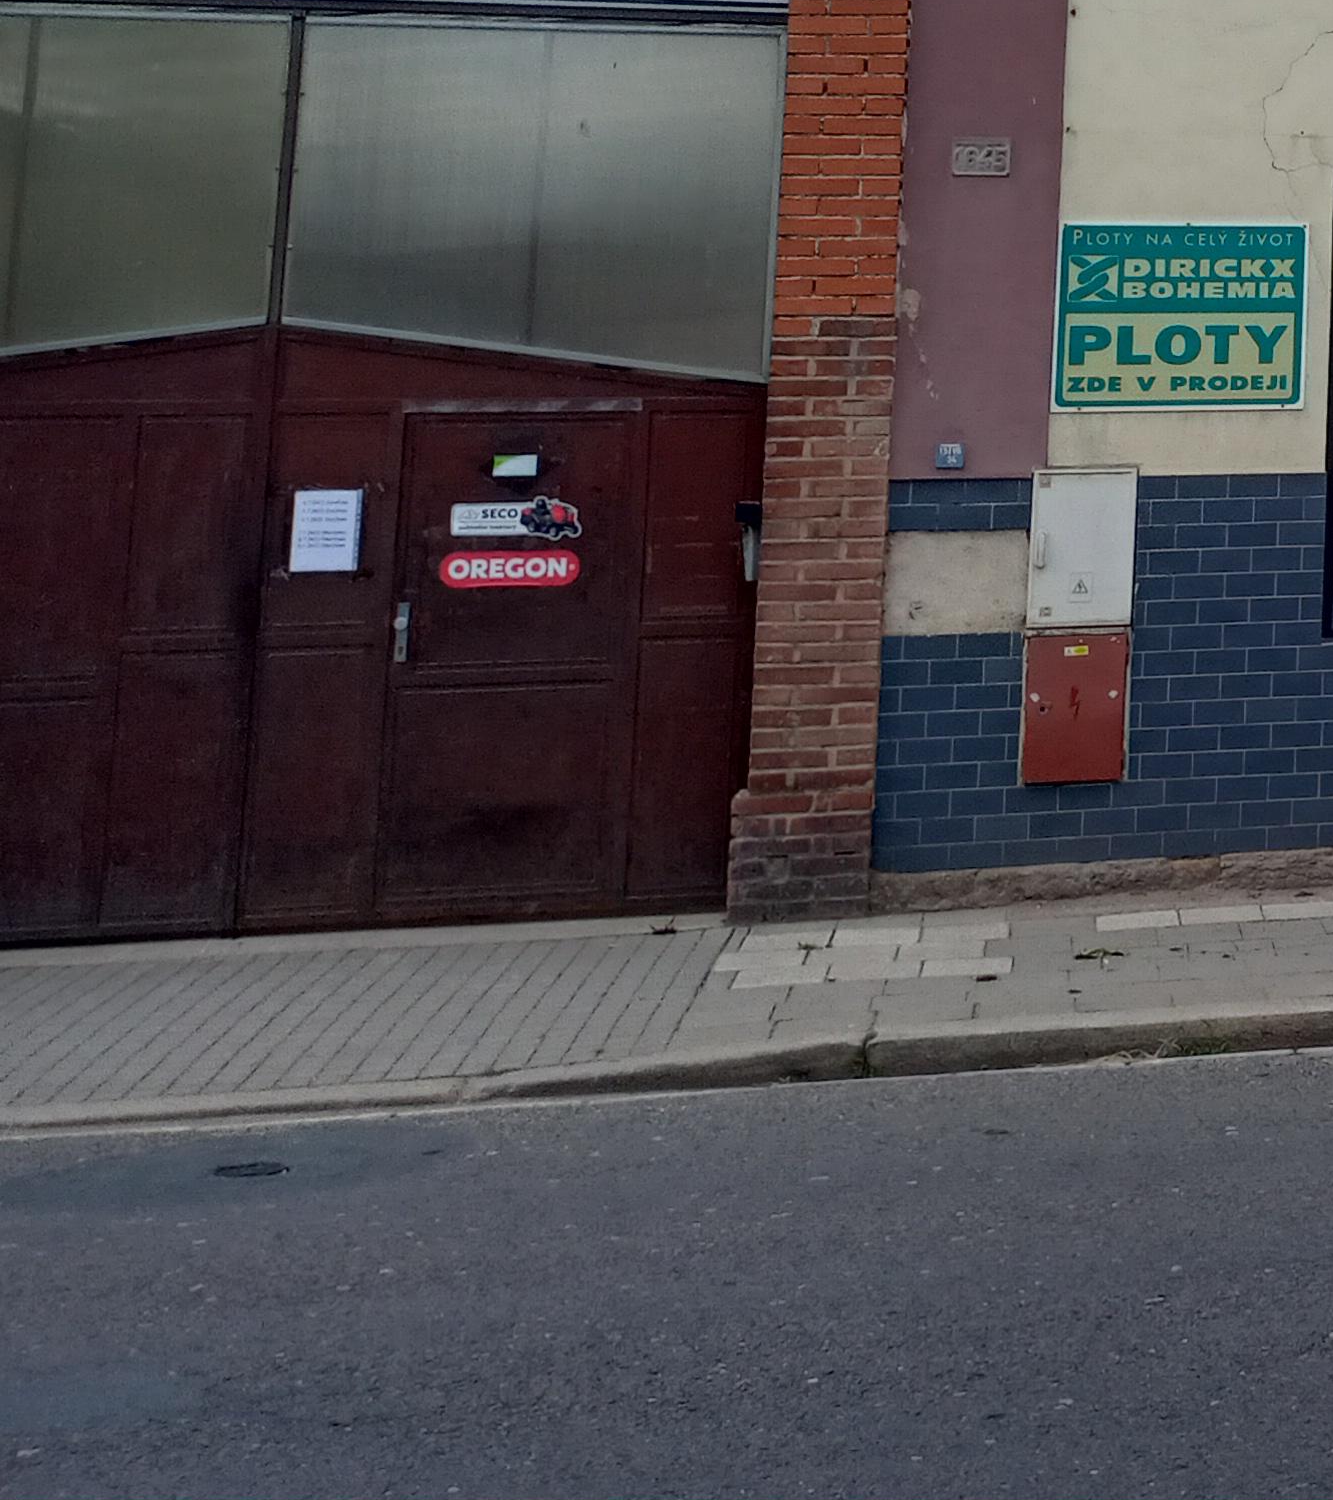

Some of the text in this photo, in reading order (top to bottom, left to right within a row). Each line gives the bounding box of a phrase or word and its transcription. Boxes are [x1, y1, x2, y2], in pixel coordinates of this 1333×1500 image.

[1146, 233, 1173, 246] NA
[1184, 230, 1228, 247] CELÝ
[1238, 229, 1295, 247] ŽIVOT
[1123, 258, 1297, 278] DIRICKX
[1122, 281, 1296, 299] BOHEMIA
[1068, 325, 1289, 366] PLOTY
[1067, 374, 1288, 393] ZDE V PRODEJI
[481, 508, 519, 519] SECO
[447, 557, 568, 580] OREGON
